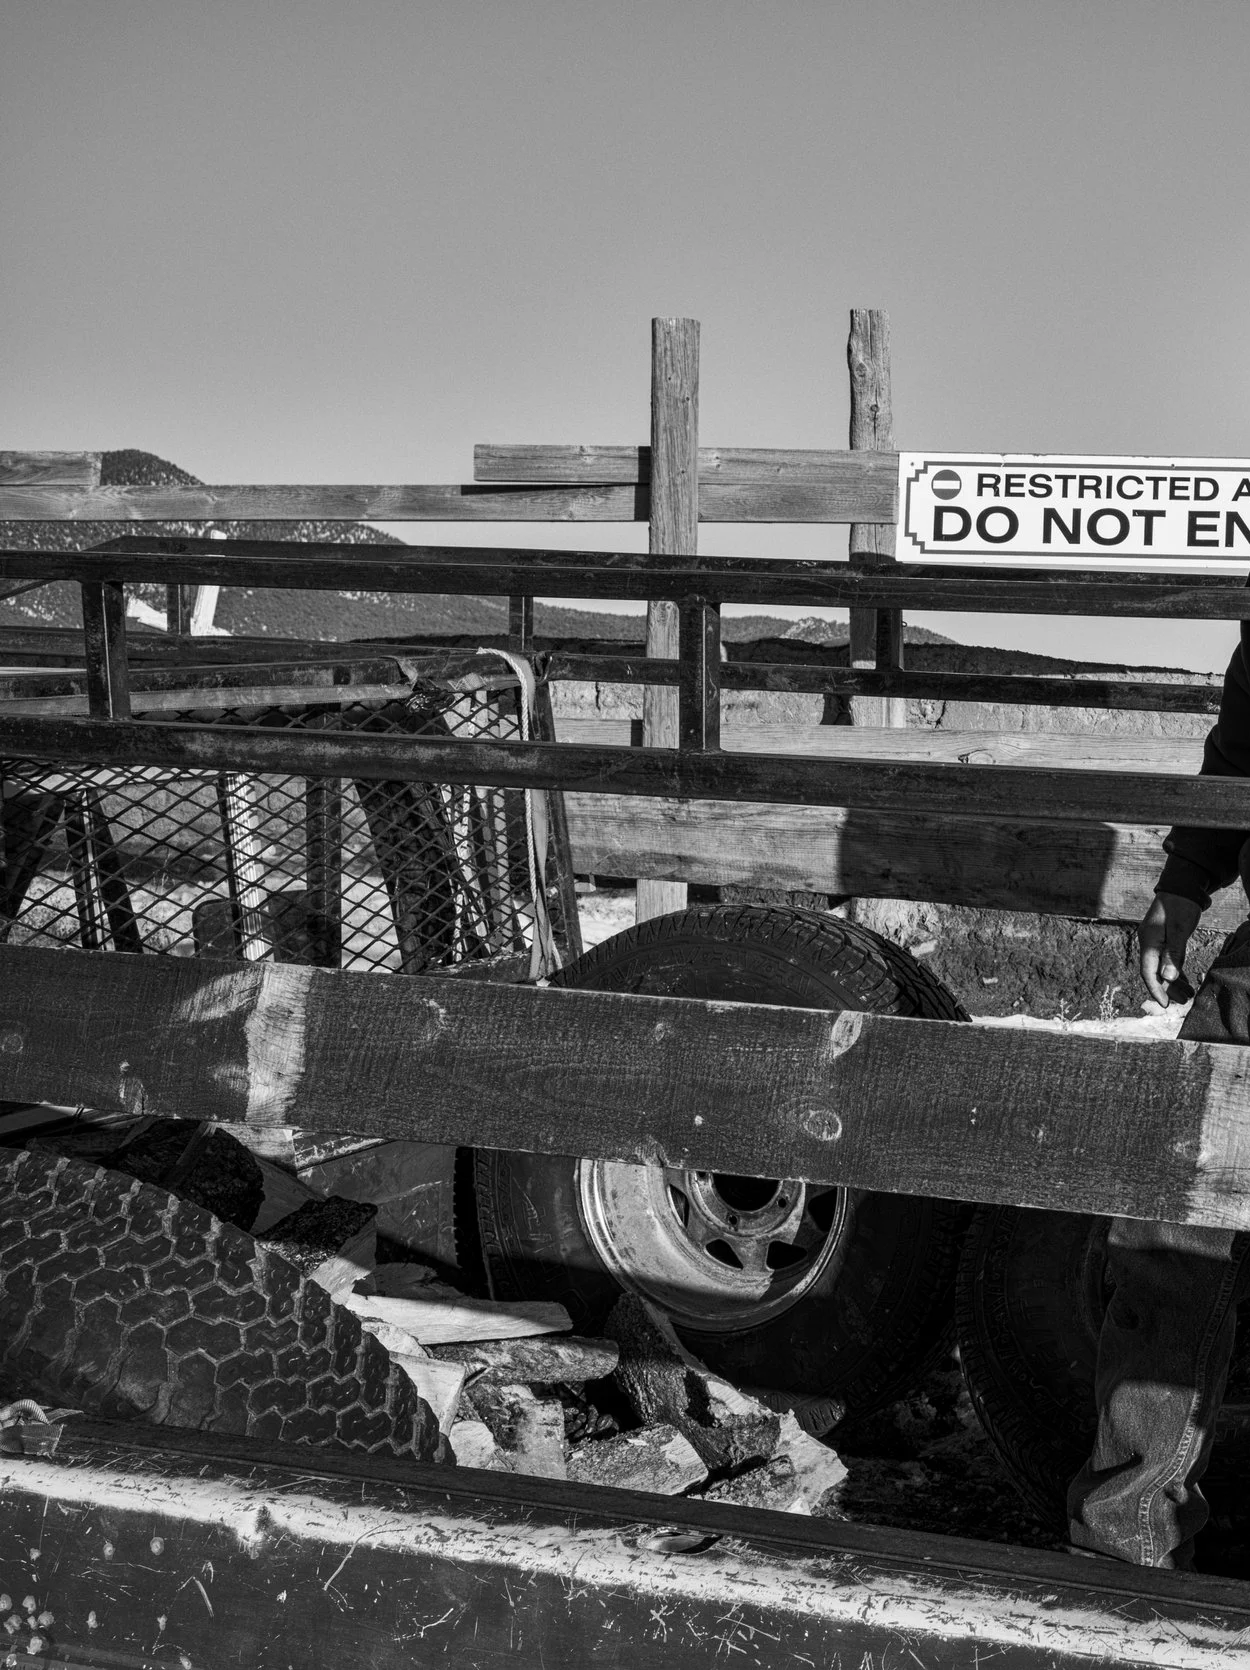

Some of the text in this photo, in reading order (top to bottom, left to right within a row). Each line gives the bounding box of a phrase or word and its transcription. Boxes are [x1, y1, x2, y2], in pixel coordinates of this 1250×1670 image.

[976, 472, 1219, 502] RESTRICTED
[932, 505, 1020, 545] DO
[1042, 507, 1166, 547] NOT
